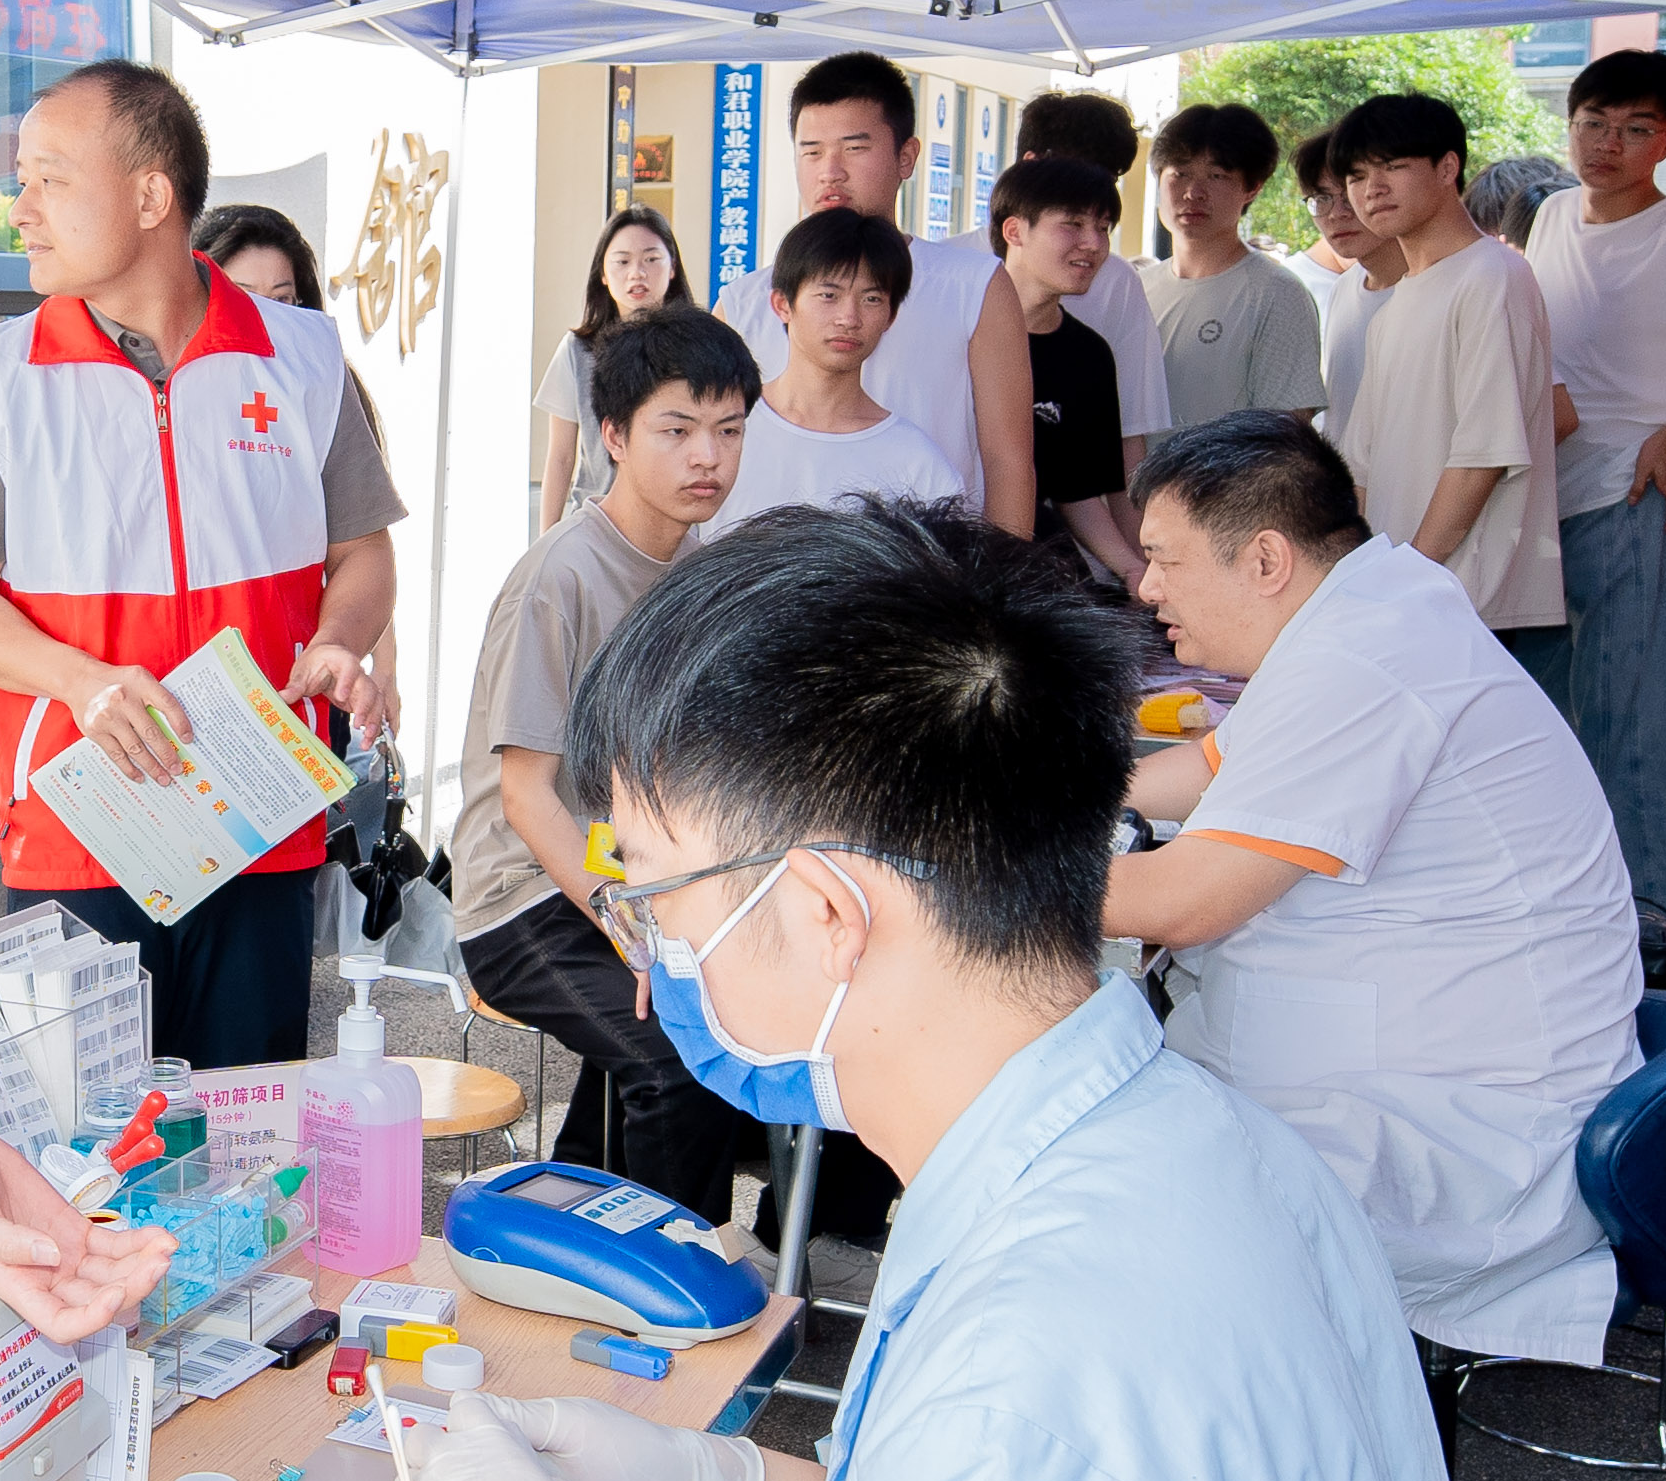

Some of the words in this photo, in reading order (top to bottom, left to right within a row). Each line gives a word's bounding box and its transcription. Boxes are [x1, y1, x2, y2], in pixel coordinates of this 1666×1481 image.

[718, 71, 753, 285] 和君职业学院产教融合研
